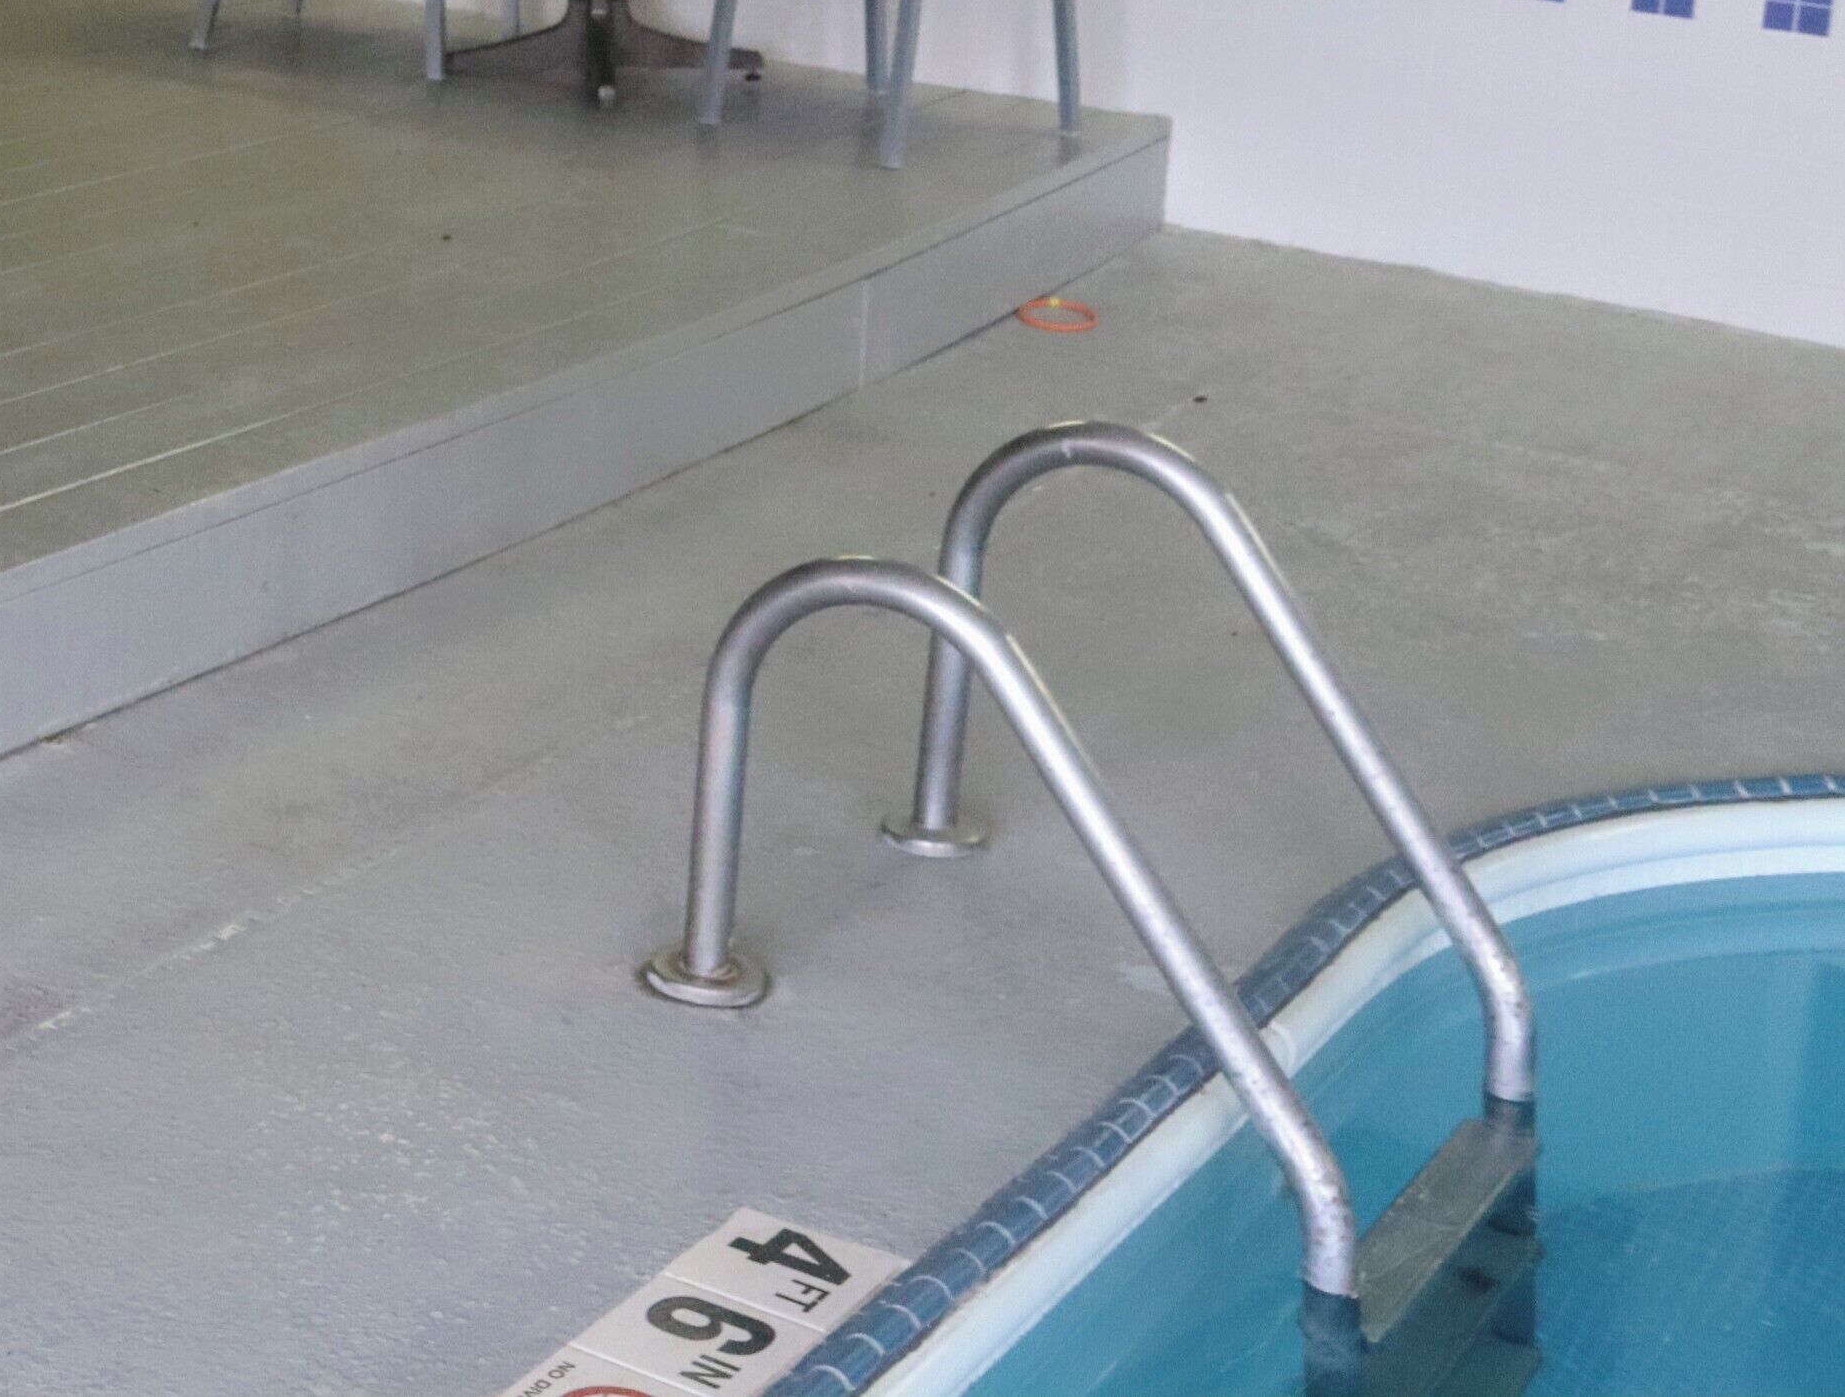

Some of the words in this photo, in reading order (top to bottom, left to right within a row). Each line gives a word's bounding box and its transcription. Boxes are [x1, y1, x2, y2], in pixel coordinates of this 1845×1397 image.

[727, 1227, 852, 1287] 4
[774, 1277, 832, 1314] FT
[645, 1295, 777, 1357] 6
[516, 1379, 552, 1397] DIV
[547, 1360, 577, 1380] NO
[679, 1353, 743, 1390] IN
